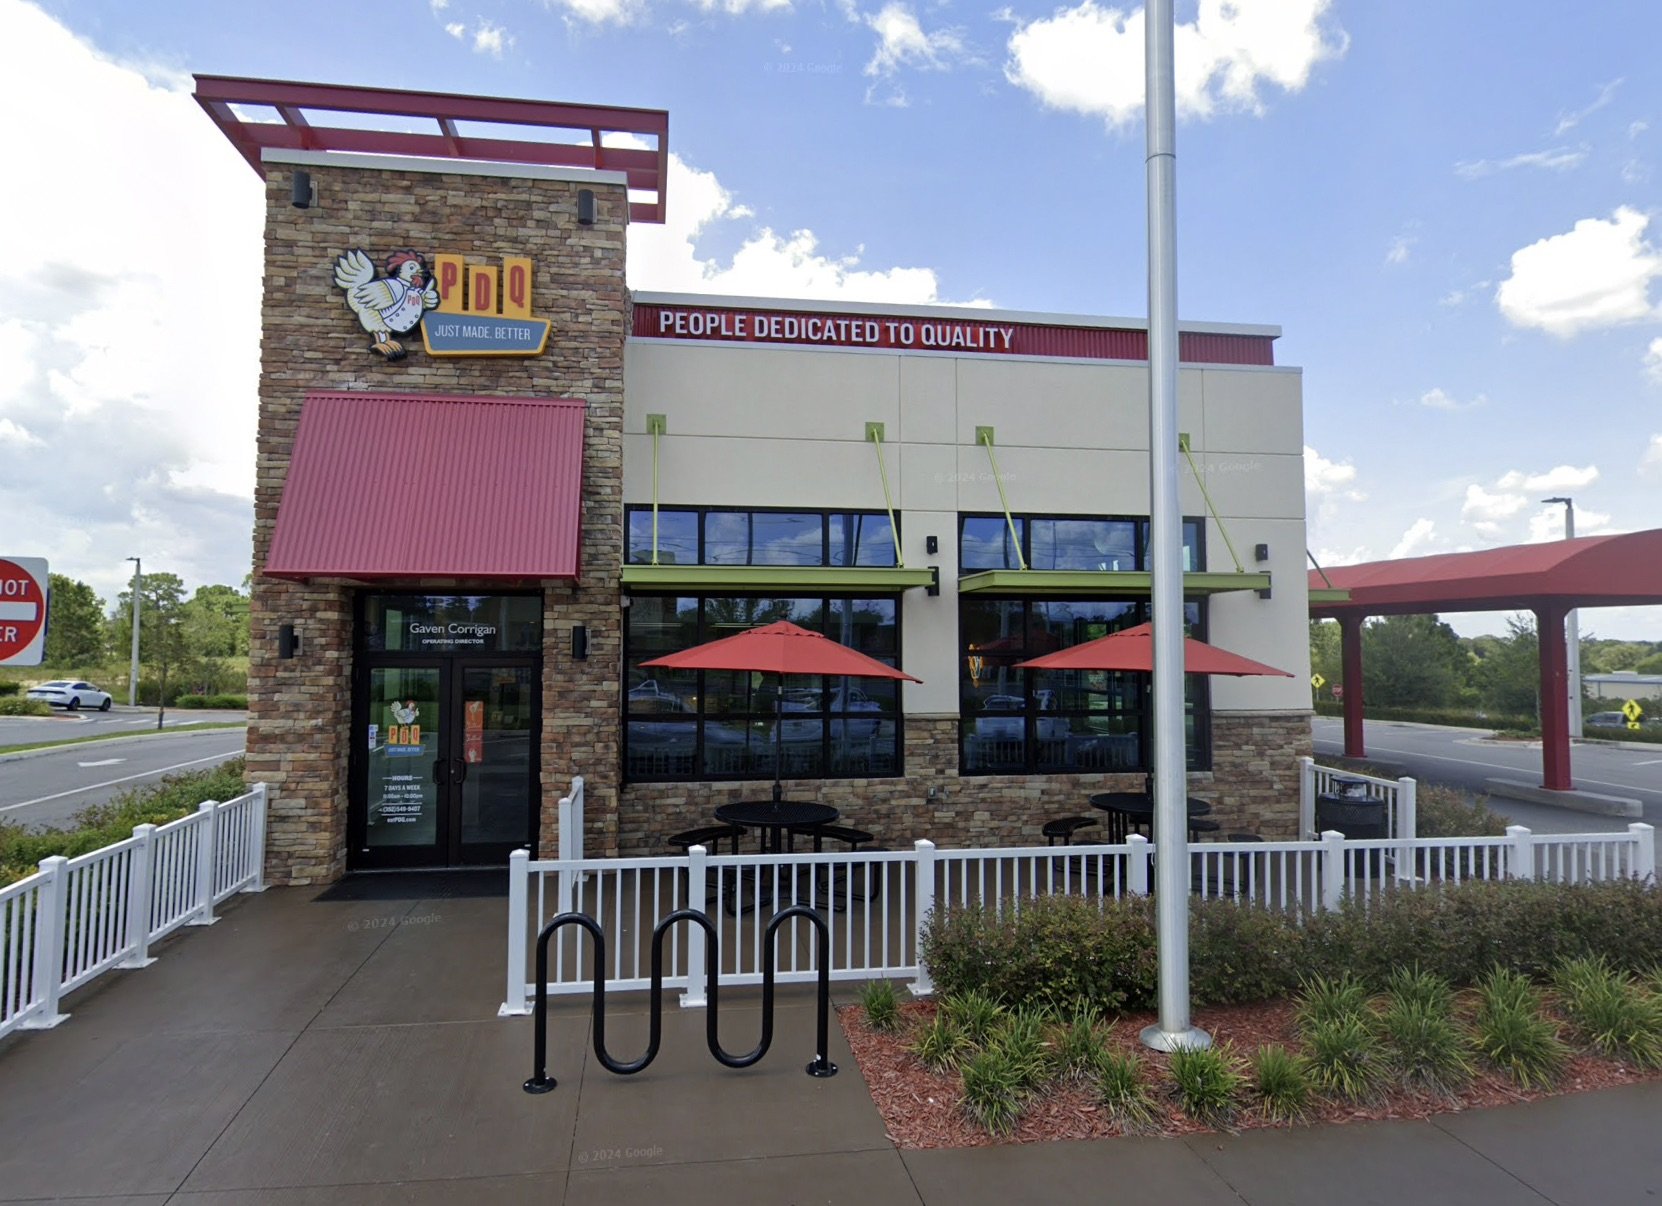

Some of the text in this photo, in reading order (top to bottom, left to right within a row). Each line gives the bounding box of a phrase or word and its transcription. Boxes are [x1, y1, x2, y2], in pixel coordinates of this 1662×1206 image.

[442, 261, 525, 311] PDQ
[434, 324, 531, 341] JUST MADE. BETTER
[660, 310, 1014, 349] PEOPLE DEDICATED TO QUALITY
[0, 579, 29, 596] OT
[409, 622, 496, 637] Gaven Corrigan
